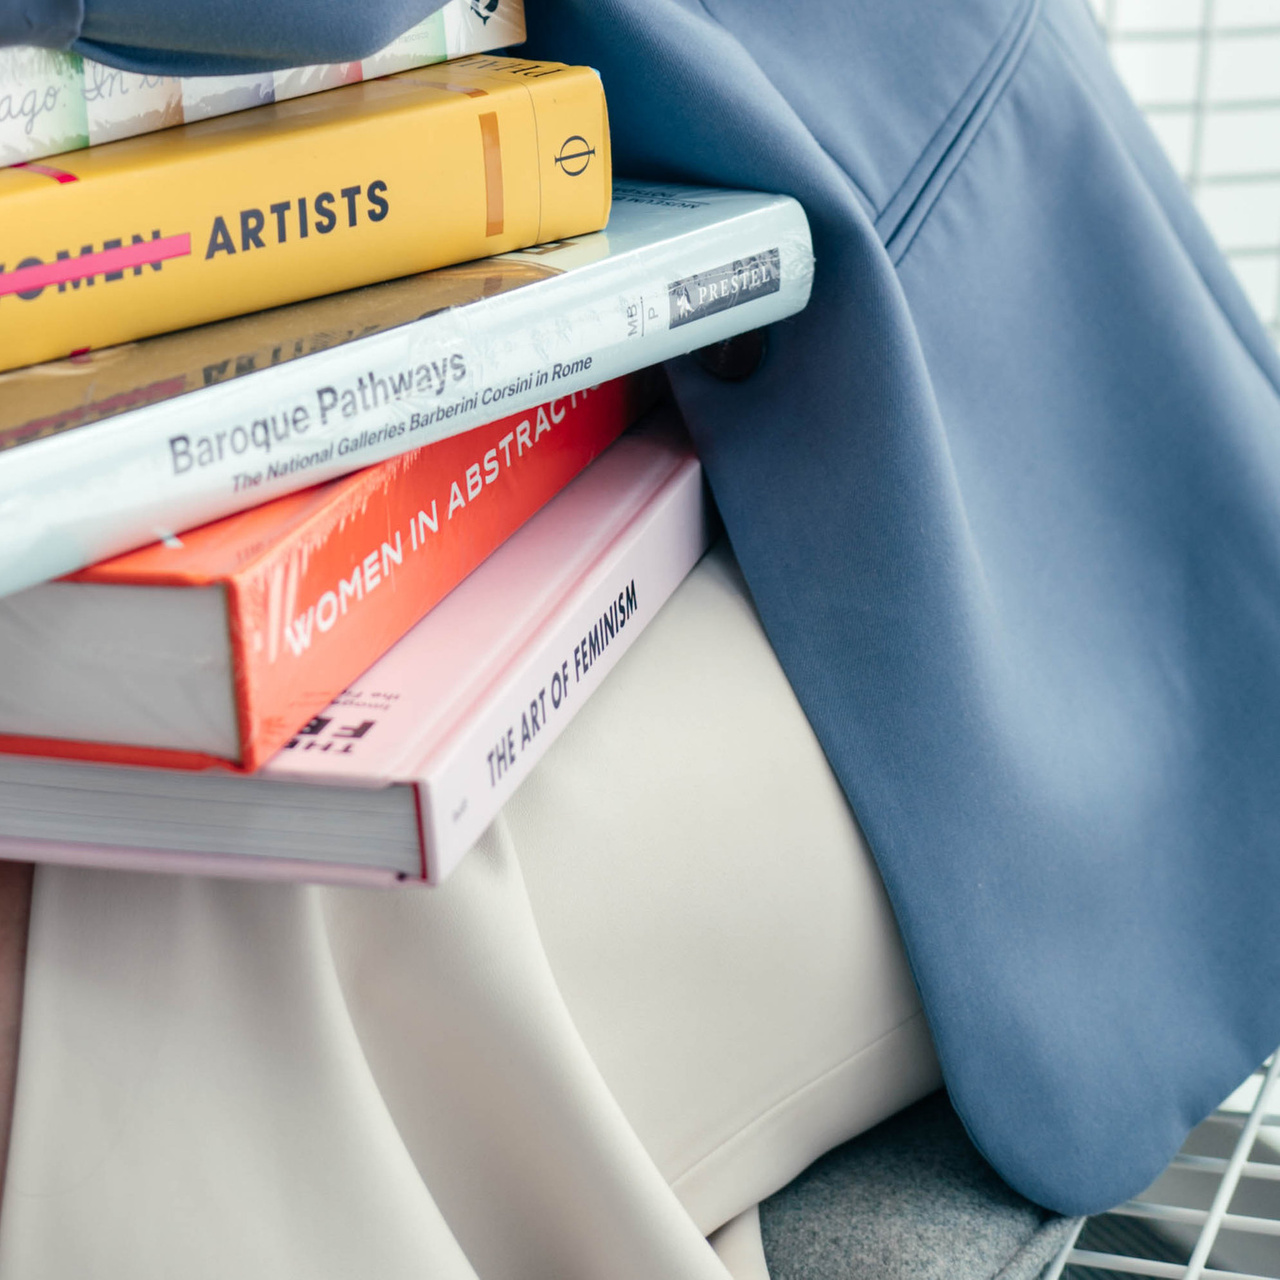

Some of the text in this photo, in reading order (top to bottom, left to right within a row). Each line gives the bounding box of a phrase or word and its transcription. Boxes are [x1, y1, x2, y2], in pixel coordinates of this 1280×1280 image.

[205, 179, 390, 260] ARTISTS
[698, 265, 771, 305] PRESTEL
[168, 353, 467, 475] Baroque Pathways
[232, 357, 592, 492] The National Galleries Barberini Corsini in Rome
[284, 531, 403, 656] WOMEN
[410, 500, 440, 551] IN
[487, 579, 638, 788] THE ART OF FEMINISM
